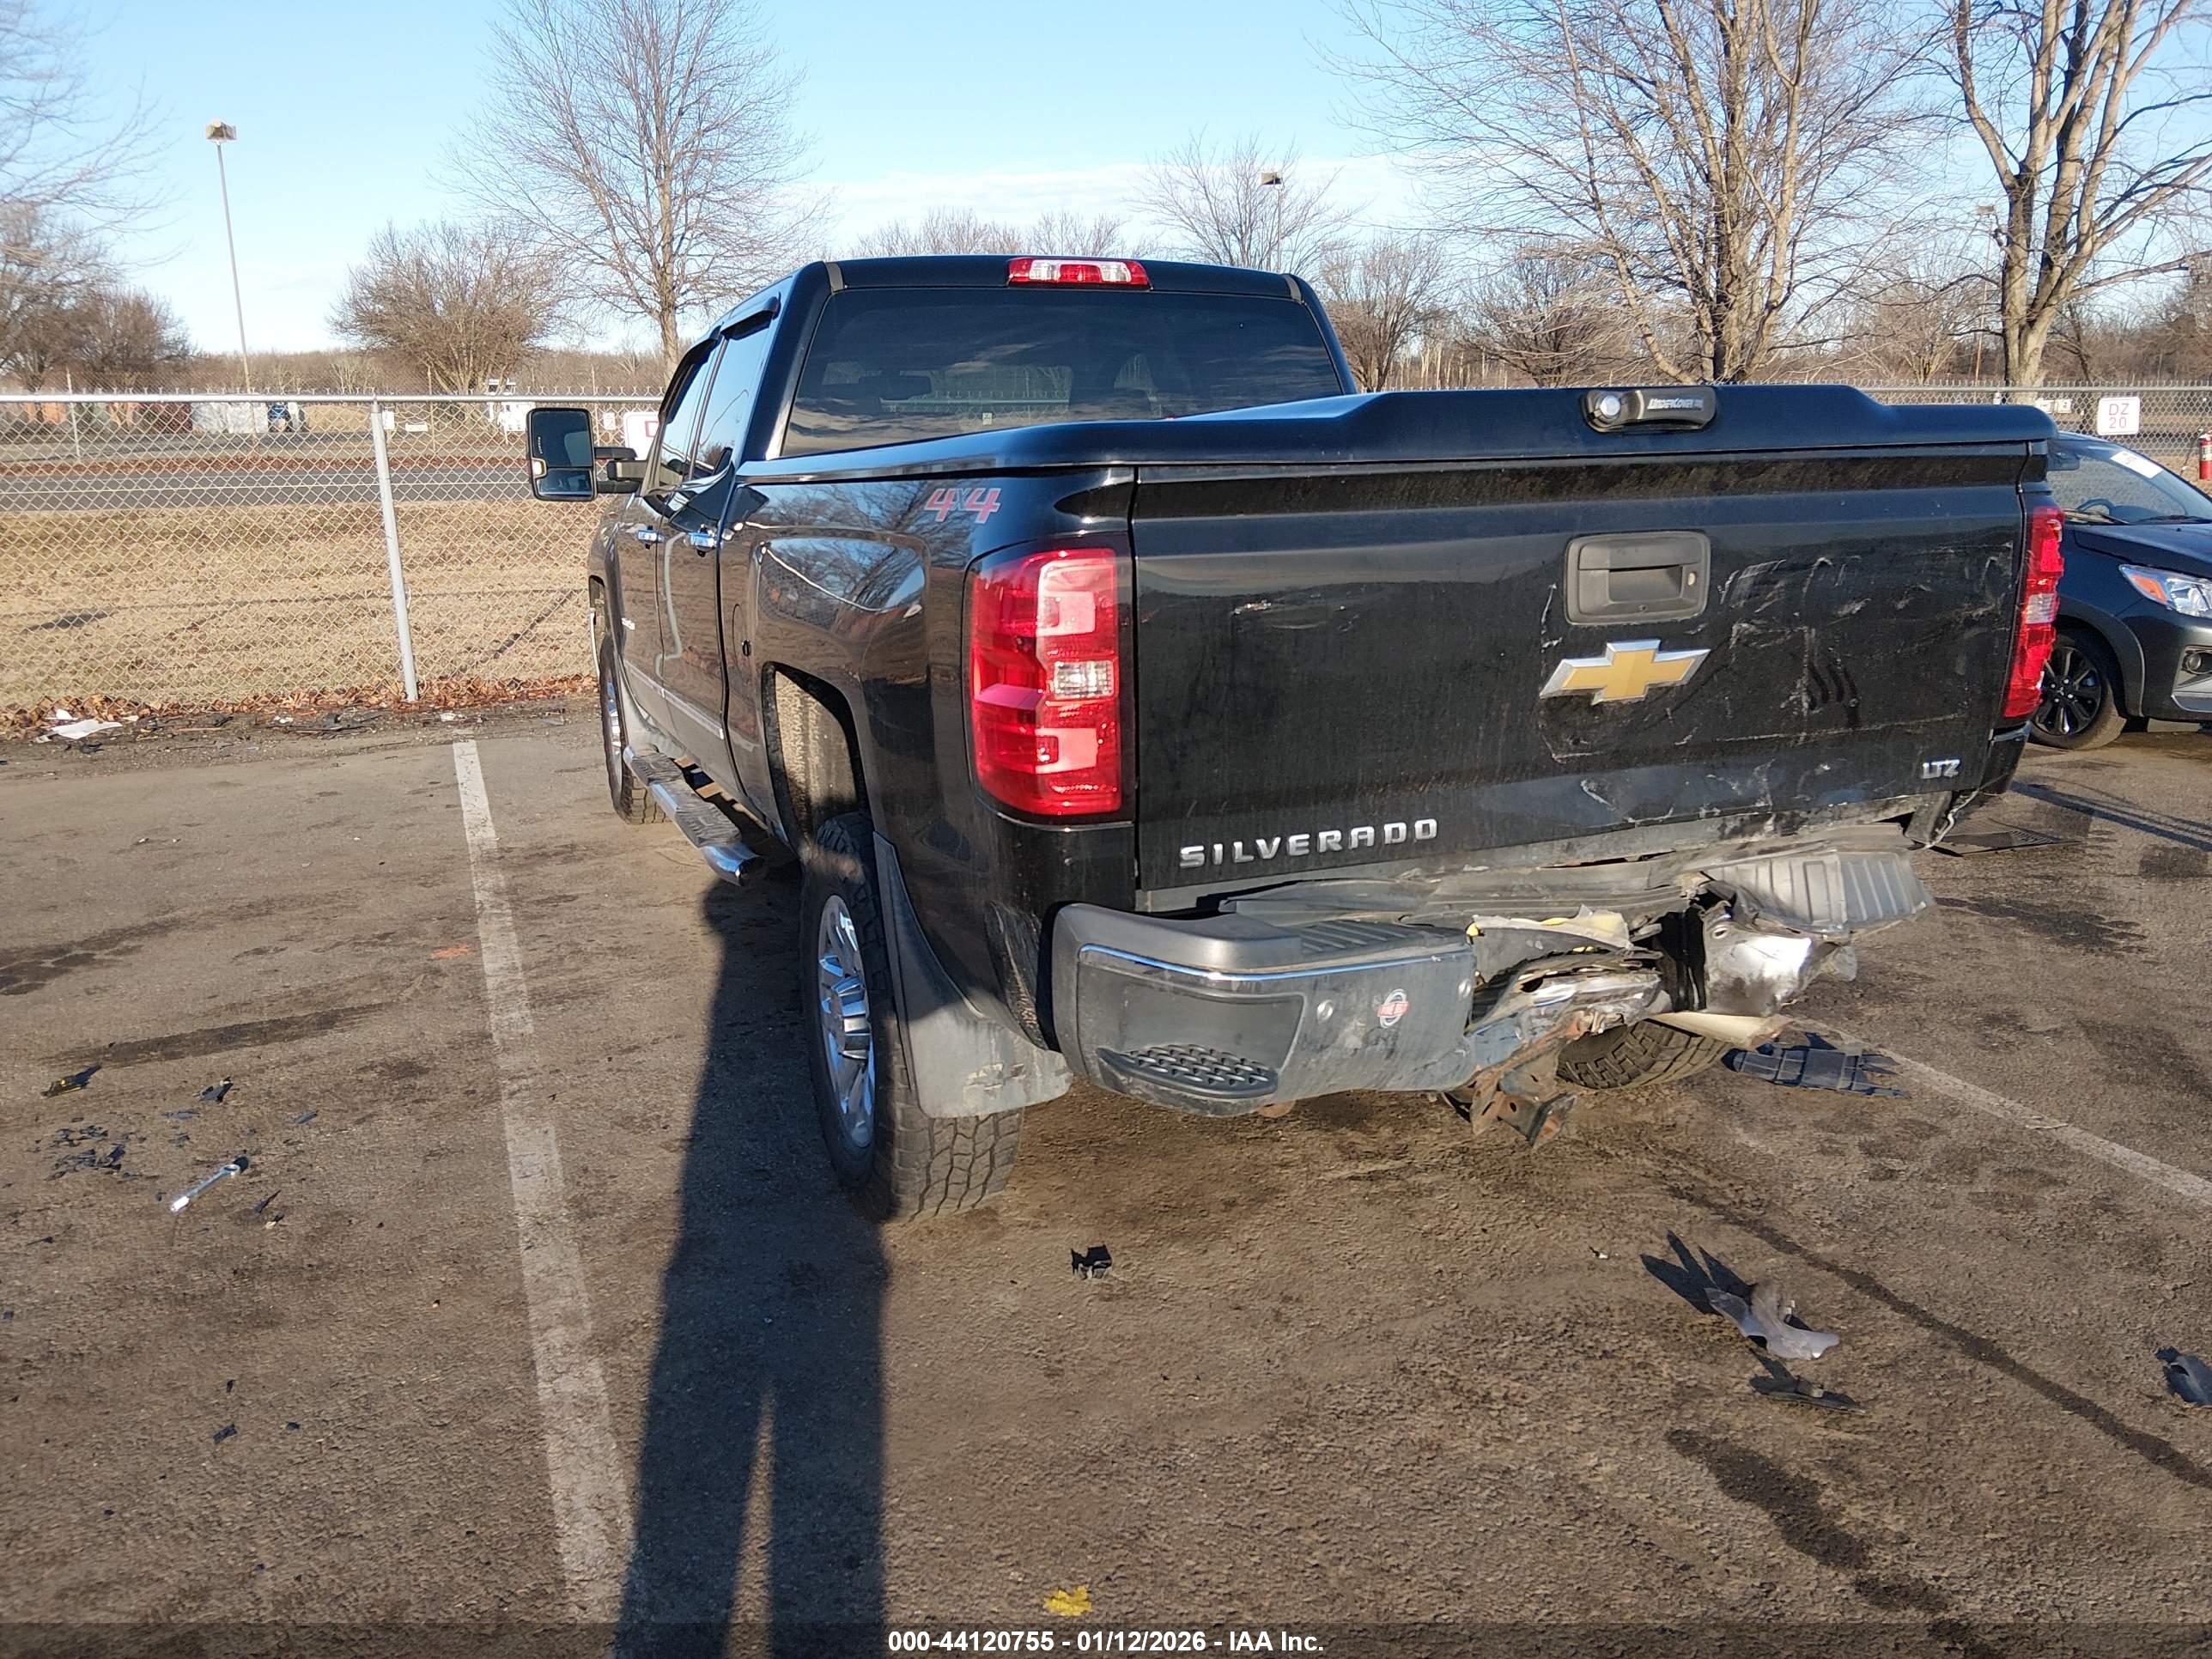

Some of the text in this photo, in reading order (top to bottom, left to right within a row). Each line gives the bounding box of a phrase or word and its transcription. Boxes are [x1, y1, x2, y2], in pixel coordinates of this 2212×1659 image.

[2109, 403, 2130, 416] DZ
[2109, 417, 2127, 428] 20
[1922, 759, 1960, 779] LTZ
[1179, 818, 1438, 868] SILVERADO
